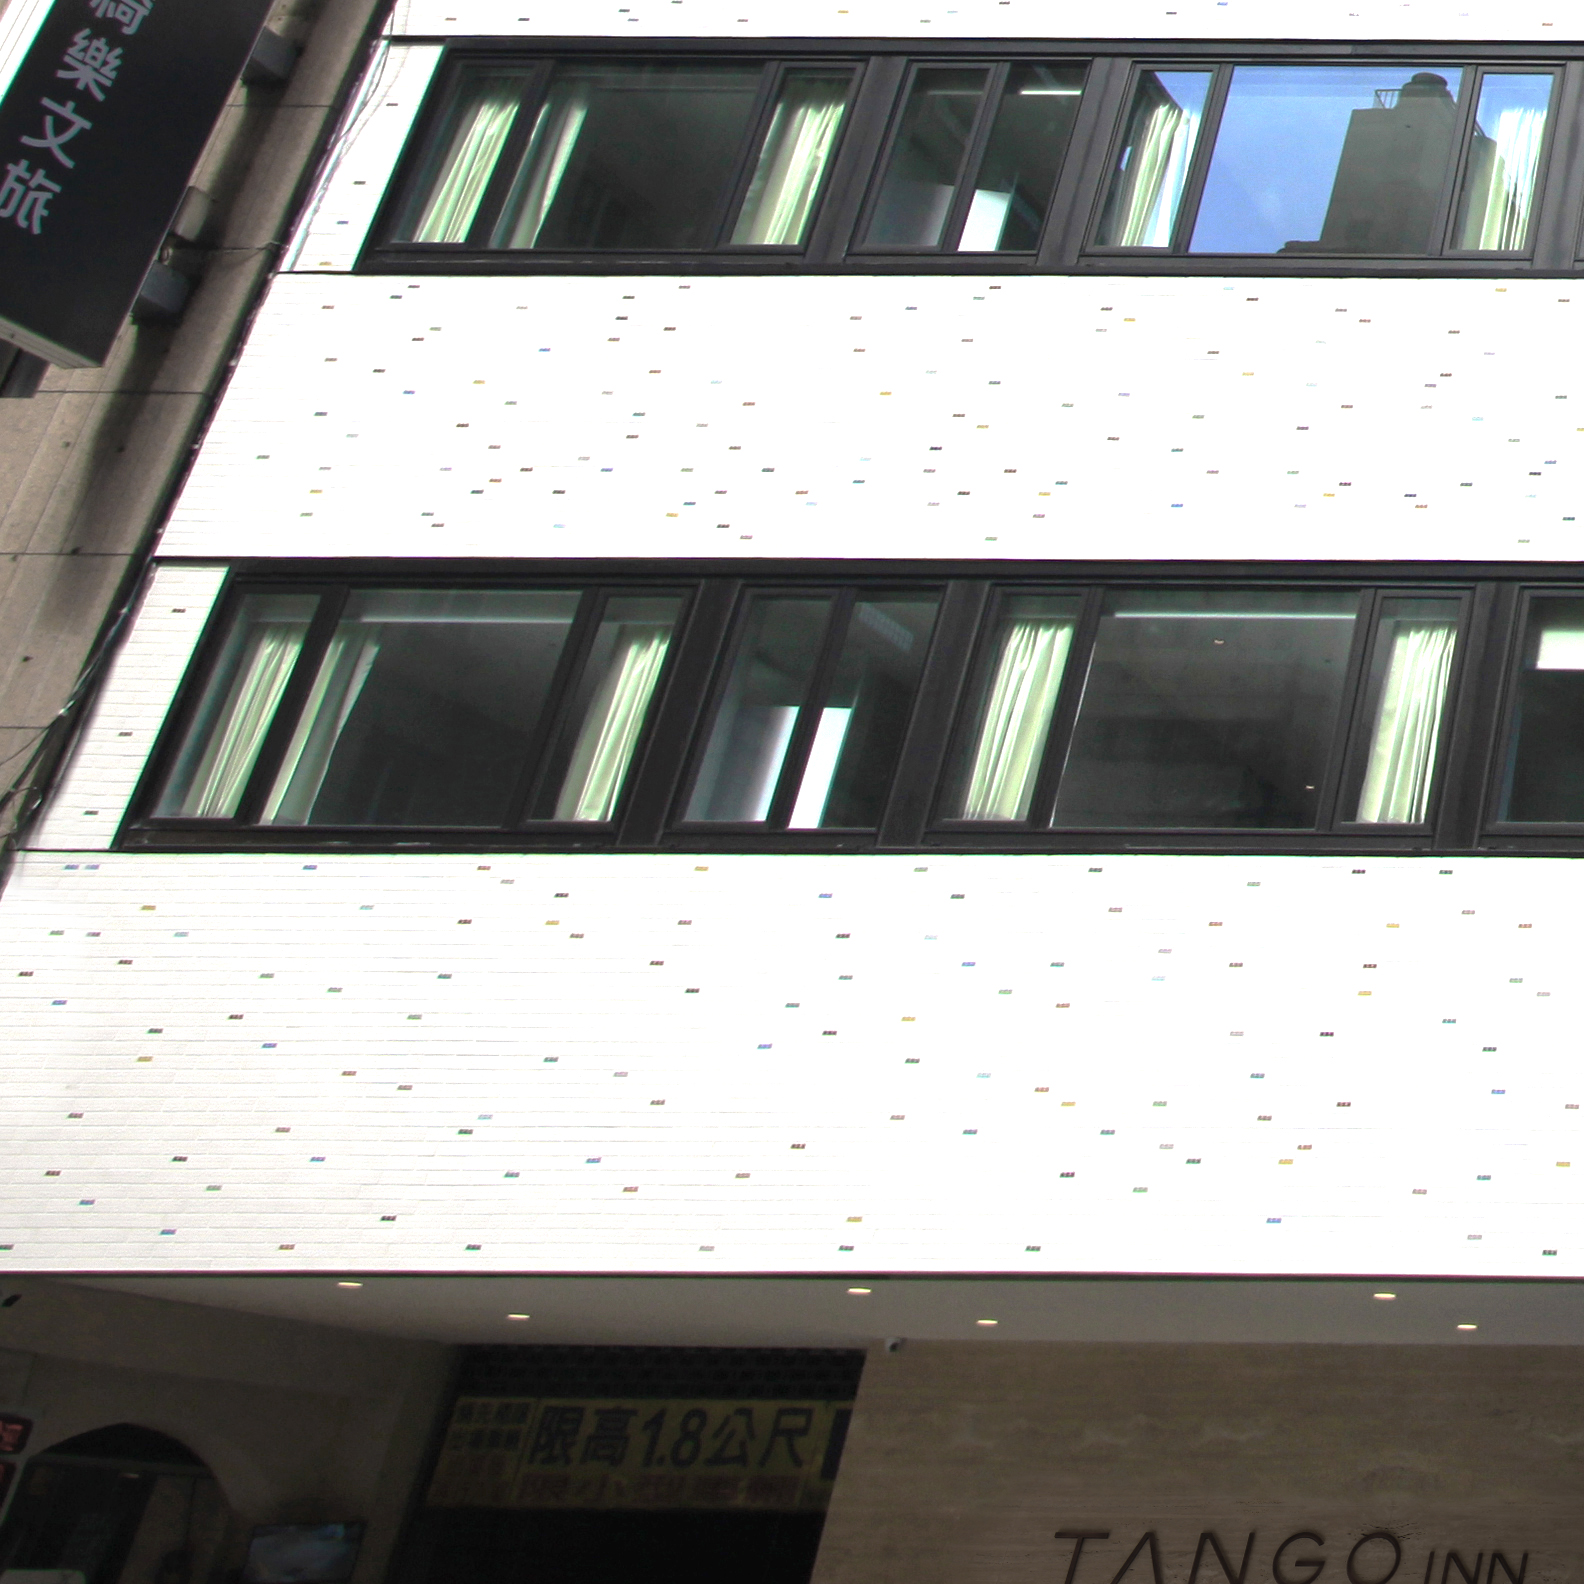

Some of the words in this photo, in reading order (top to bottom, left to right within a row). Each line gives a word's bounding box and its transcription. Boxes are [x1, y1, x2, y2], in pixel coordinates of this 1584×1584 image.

[526, 1404, 814, 1469] 限高1.8公尺
[1054, 1531, 1401, 1584] TANGO
[1424, 1550, 1529, 1584] INN
